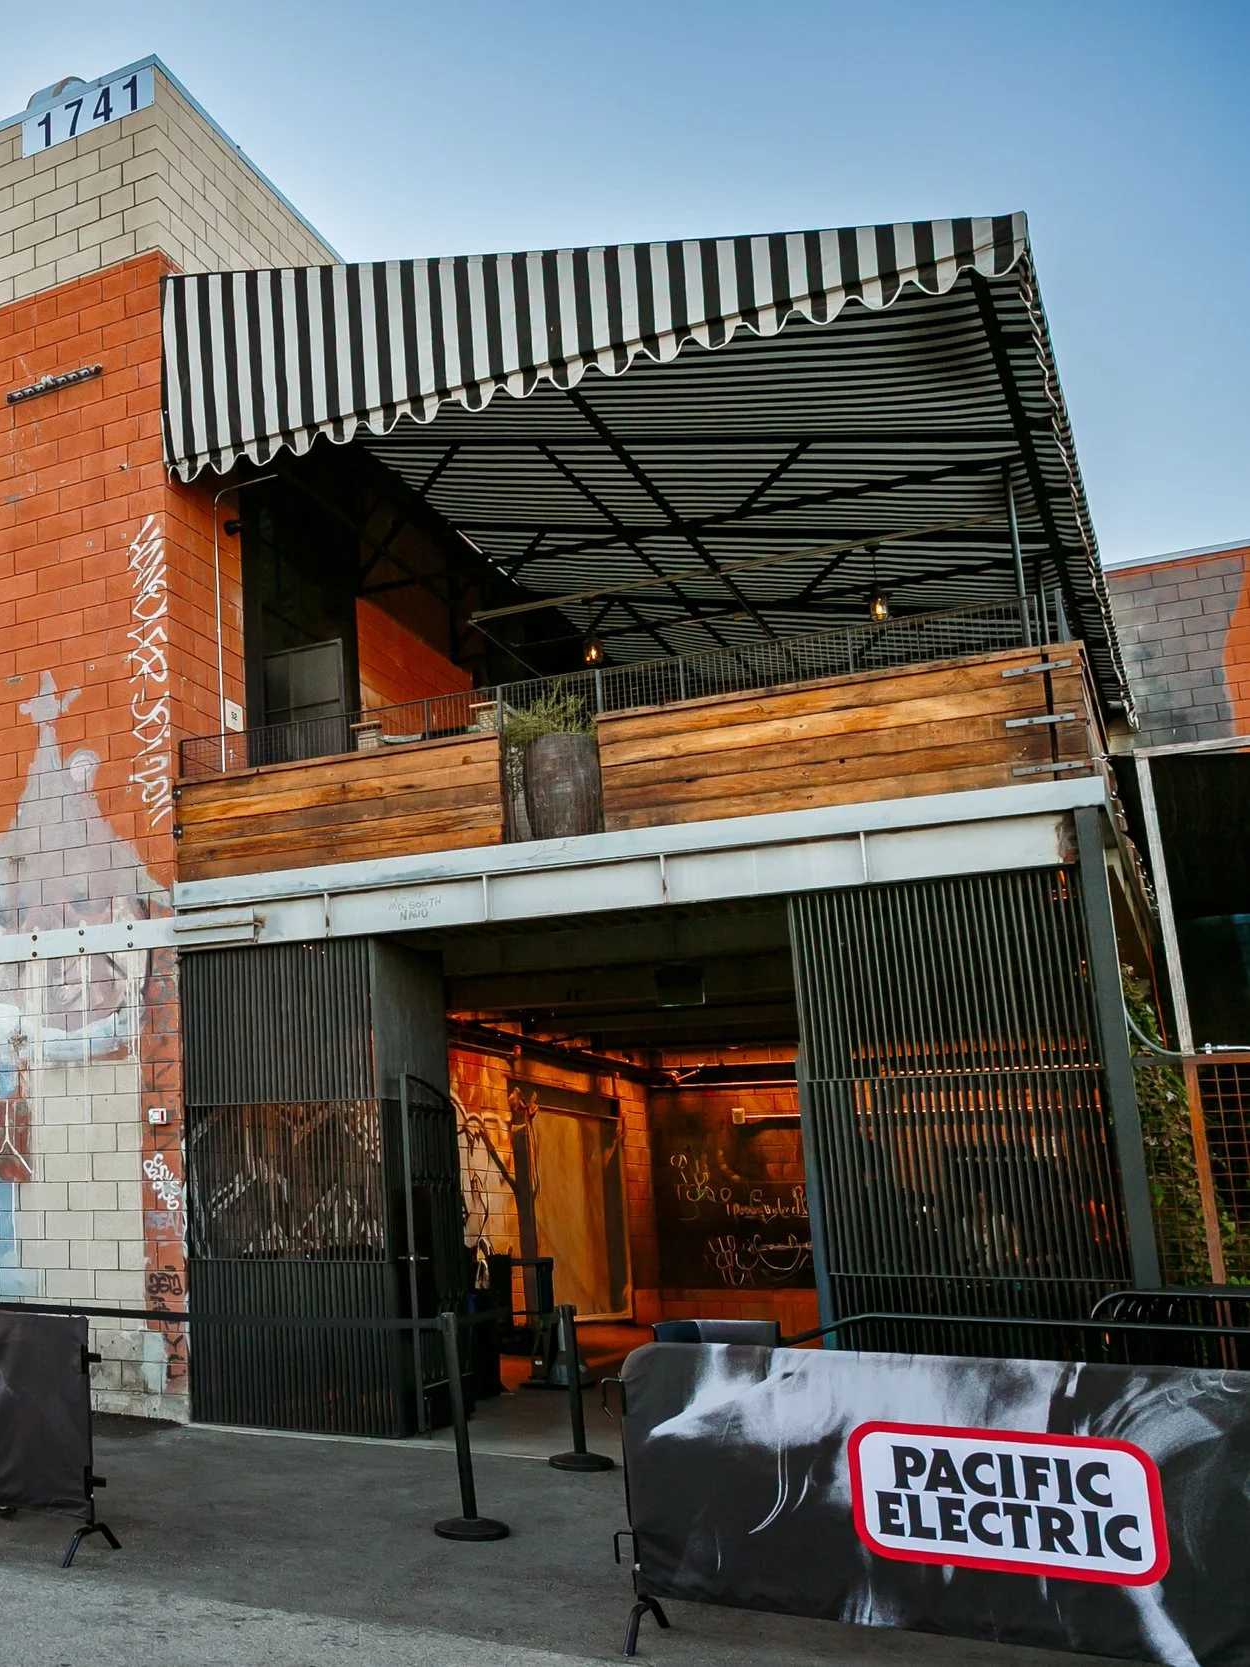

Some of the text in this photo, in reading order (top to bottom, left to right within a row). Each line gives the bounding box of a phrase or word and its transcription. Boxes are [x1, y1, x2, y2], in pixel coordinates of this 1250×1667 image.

[37, 74, 138, 148] 1741
[890, 1445, 1113, 1508] PACIFIC
[875, 1490, 1143, 1561] ELECTRIC
